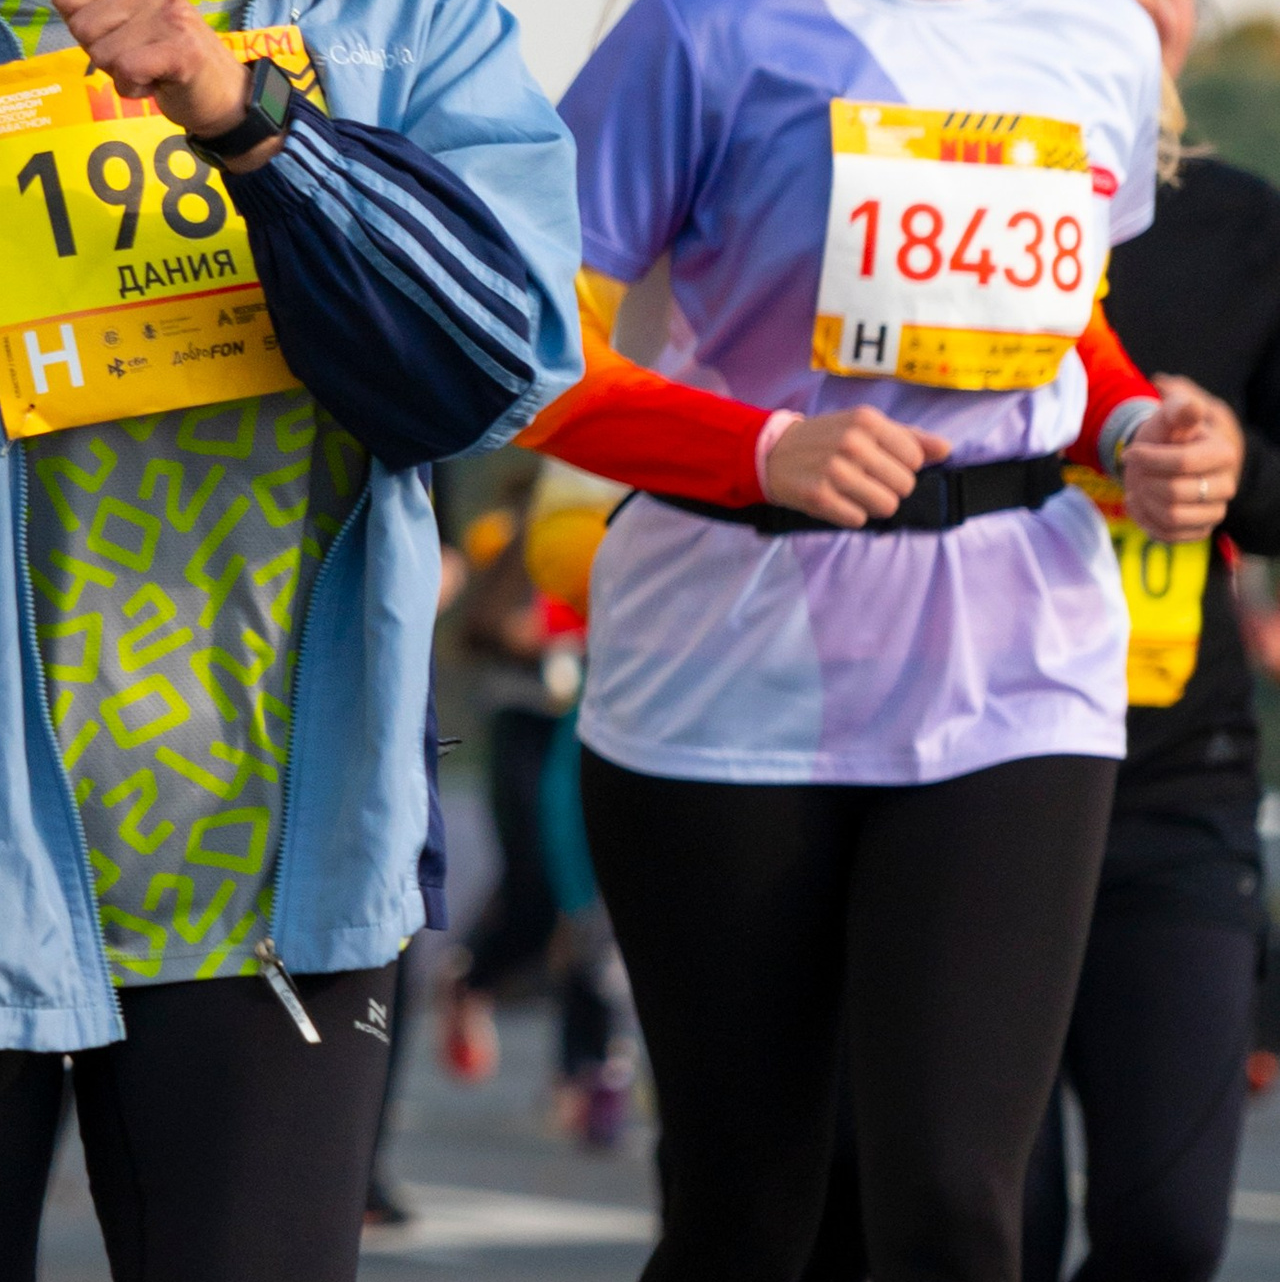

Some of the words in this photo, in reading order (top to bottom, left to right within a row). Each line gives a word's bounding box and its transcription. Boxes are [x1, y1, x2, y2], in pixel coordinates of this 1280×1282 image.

[17, 134, 240, 258] 198
[117, 249, 238, 299] ДАНИЯ
[849, 199, 1082, 292] 18438
